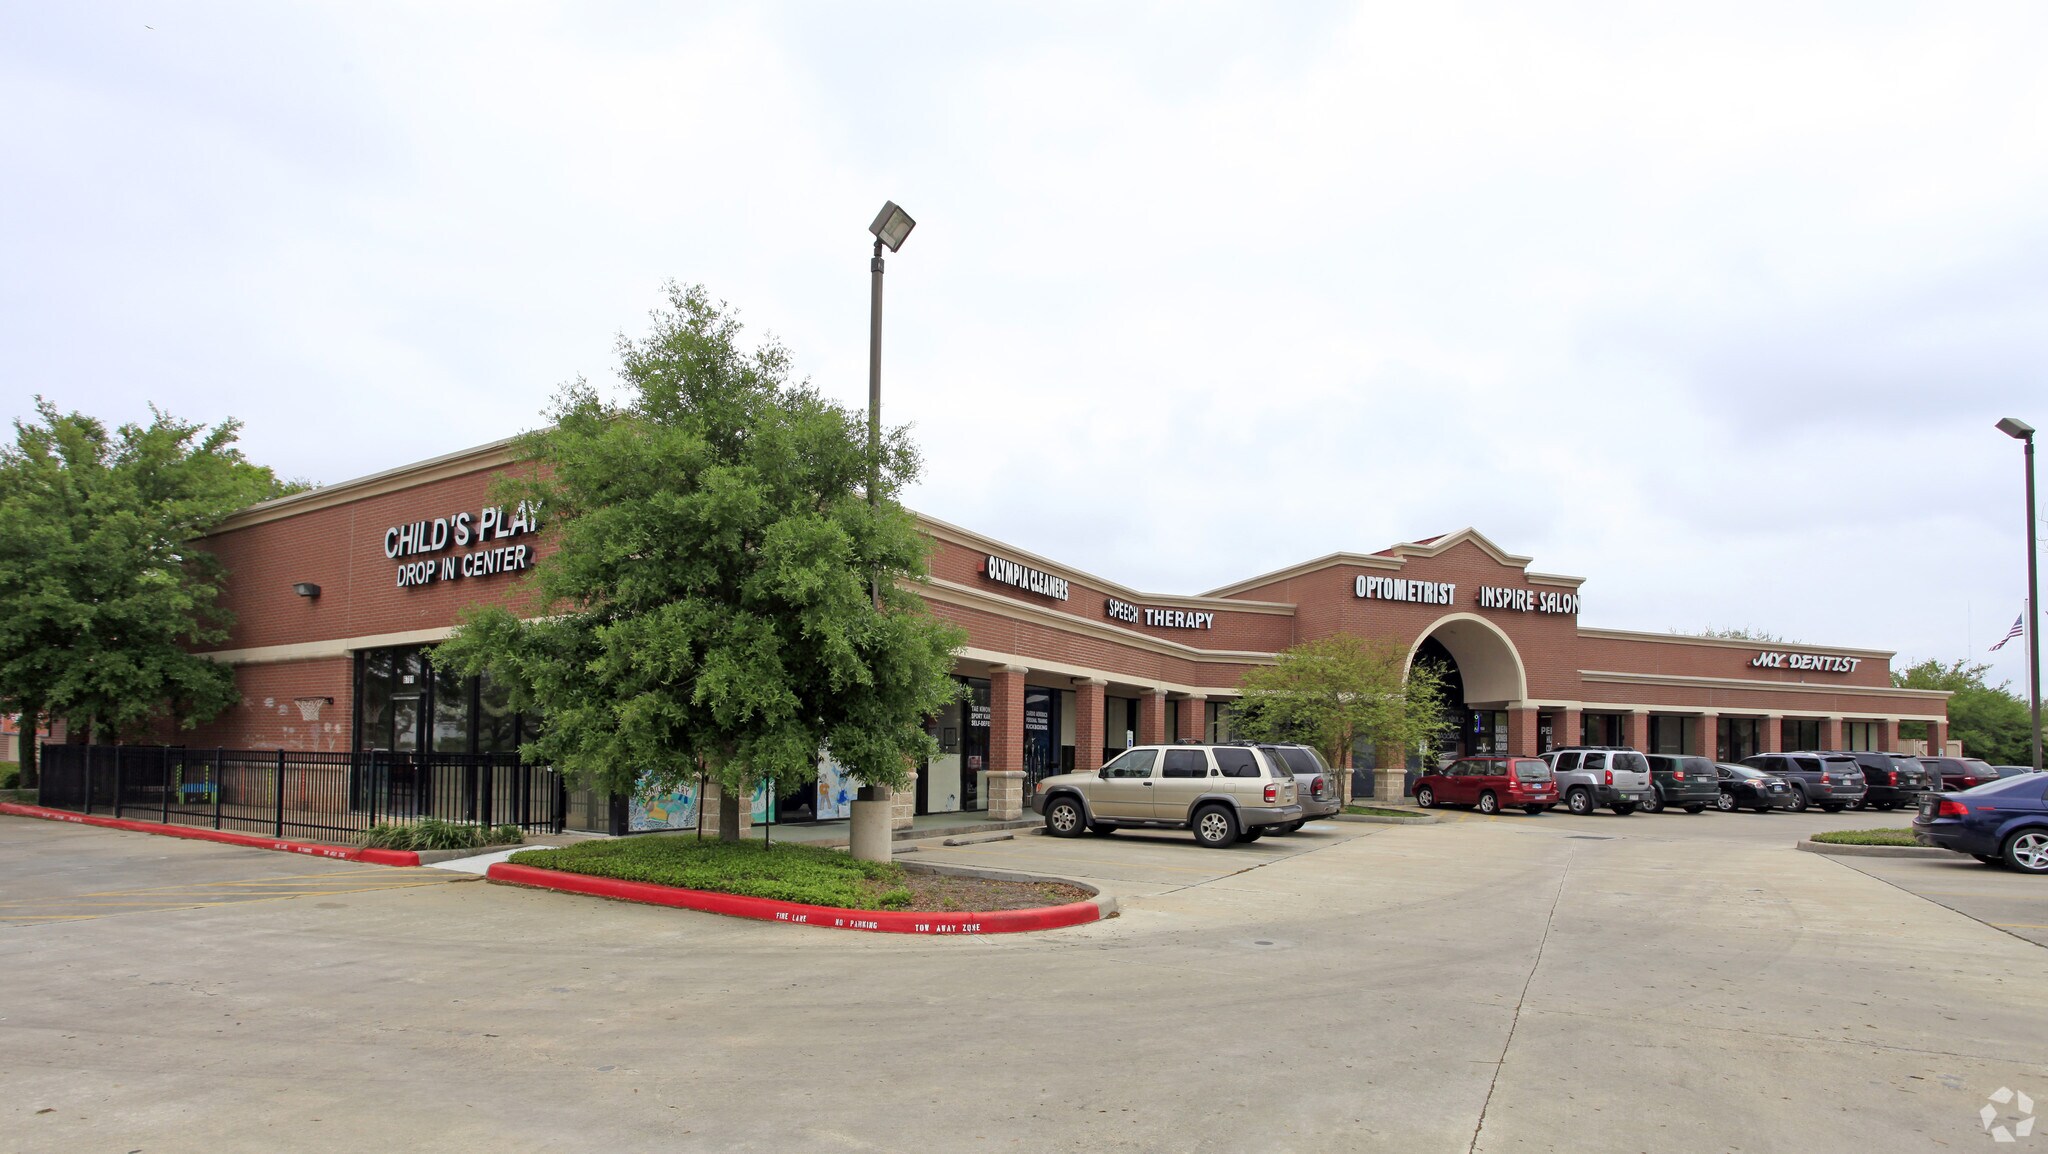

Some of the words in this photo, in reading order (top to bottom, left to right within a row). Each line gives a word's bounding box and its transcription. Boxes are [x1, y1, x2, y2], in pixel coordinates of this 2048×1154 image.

[385, 512, 470, 559] CHILD'S
[479, 498, 543, 541] PLAY
[397, 560, 436, 587] DROP
[441, 556, 456, 581] IN
[463, 544, 526, 577] CENTER
[988, 555, 1029, 590] OLYMPIA
[1030, 570, 1069, 601] CLEANERS
[1355, 575, 1456, 605] OPTOMETRIST
[1480, 586, 1534, 612] INSPIRE
[1539, 591, 1581, 614] SALON
[1108, 599, 1139, 623] SPEECH
[1144, 608, 1214, 629] THERAPY
[1752, 652, 1786, 668] MY
[1789, 653, 1861, 673] DENTIST
[792, 914, 807, 922] LANE
[835, 918, 844, 926] NO
[850, 920, 879, 929] PARKING
[915, 924, 930, 932] TOW
[962, 923, 980, 932] ZONE
